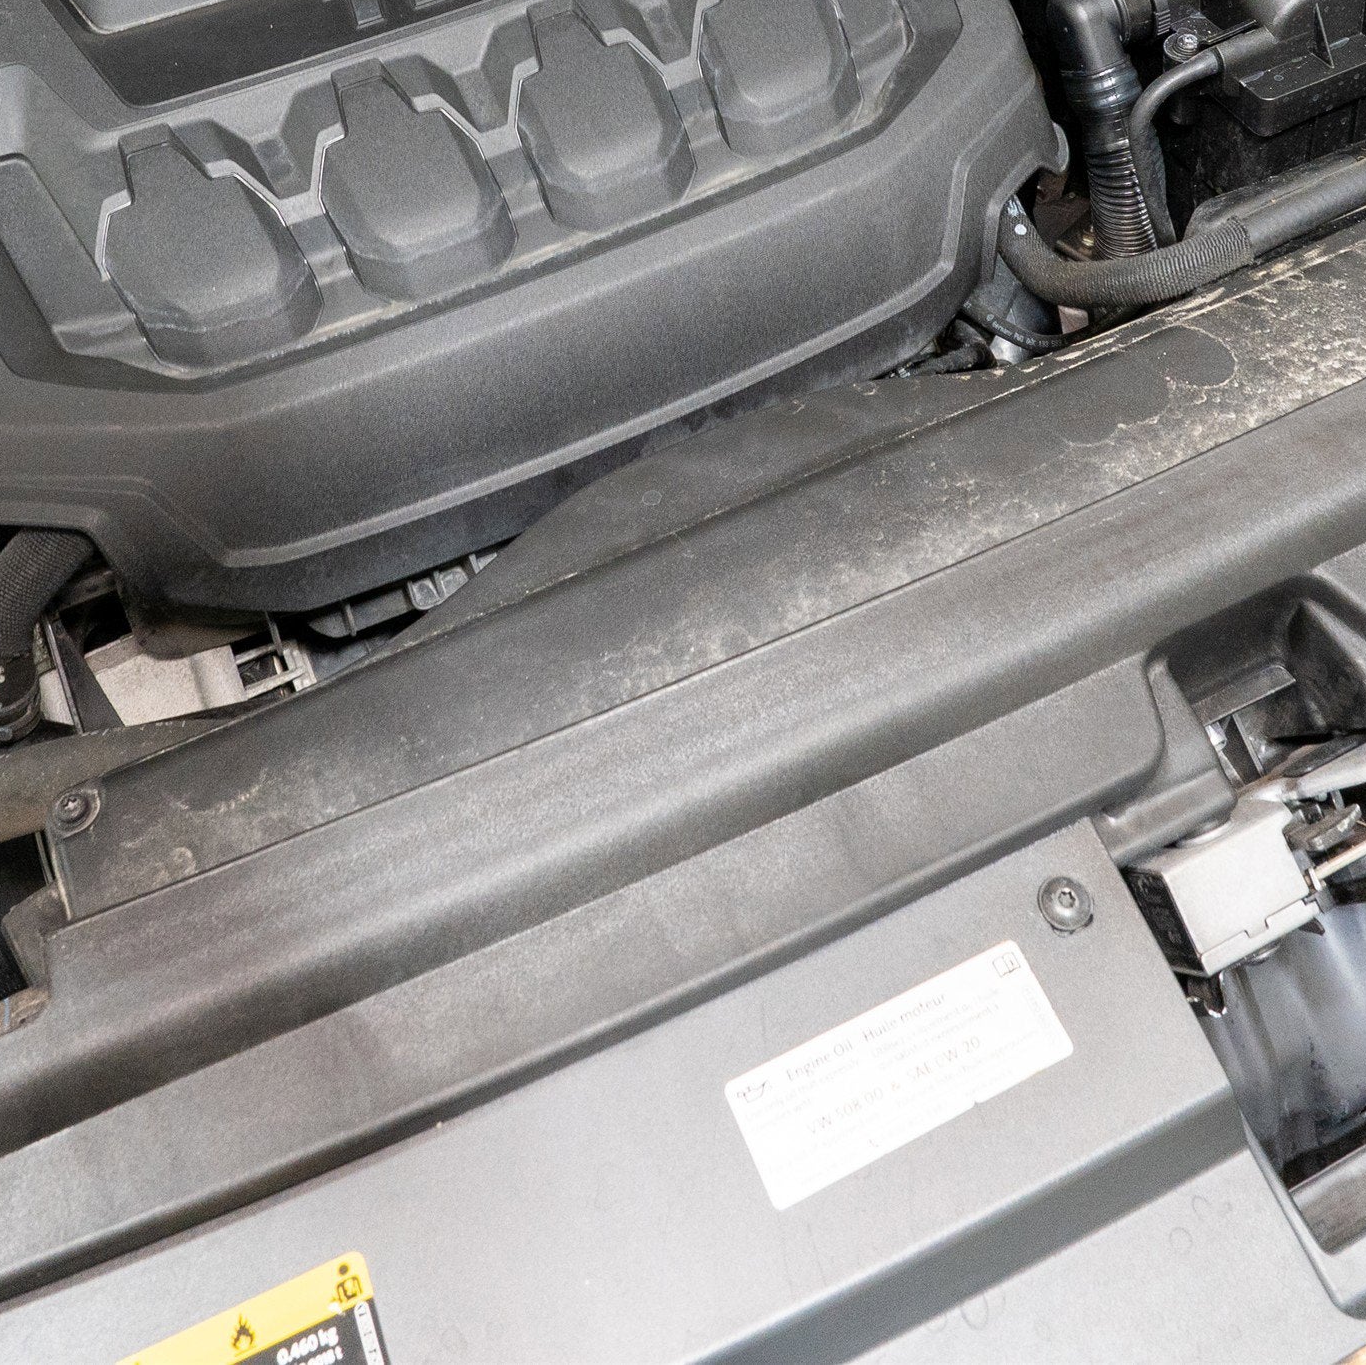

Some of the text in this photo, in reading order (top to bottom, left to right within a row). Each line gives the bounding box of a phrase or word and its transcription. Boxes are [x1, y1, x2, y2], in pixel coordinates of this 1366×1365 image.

[786, 992, 948, 1082] Engine Oil Huile moteur
[807, 1116, 833, 1135] VW
